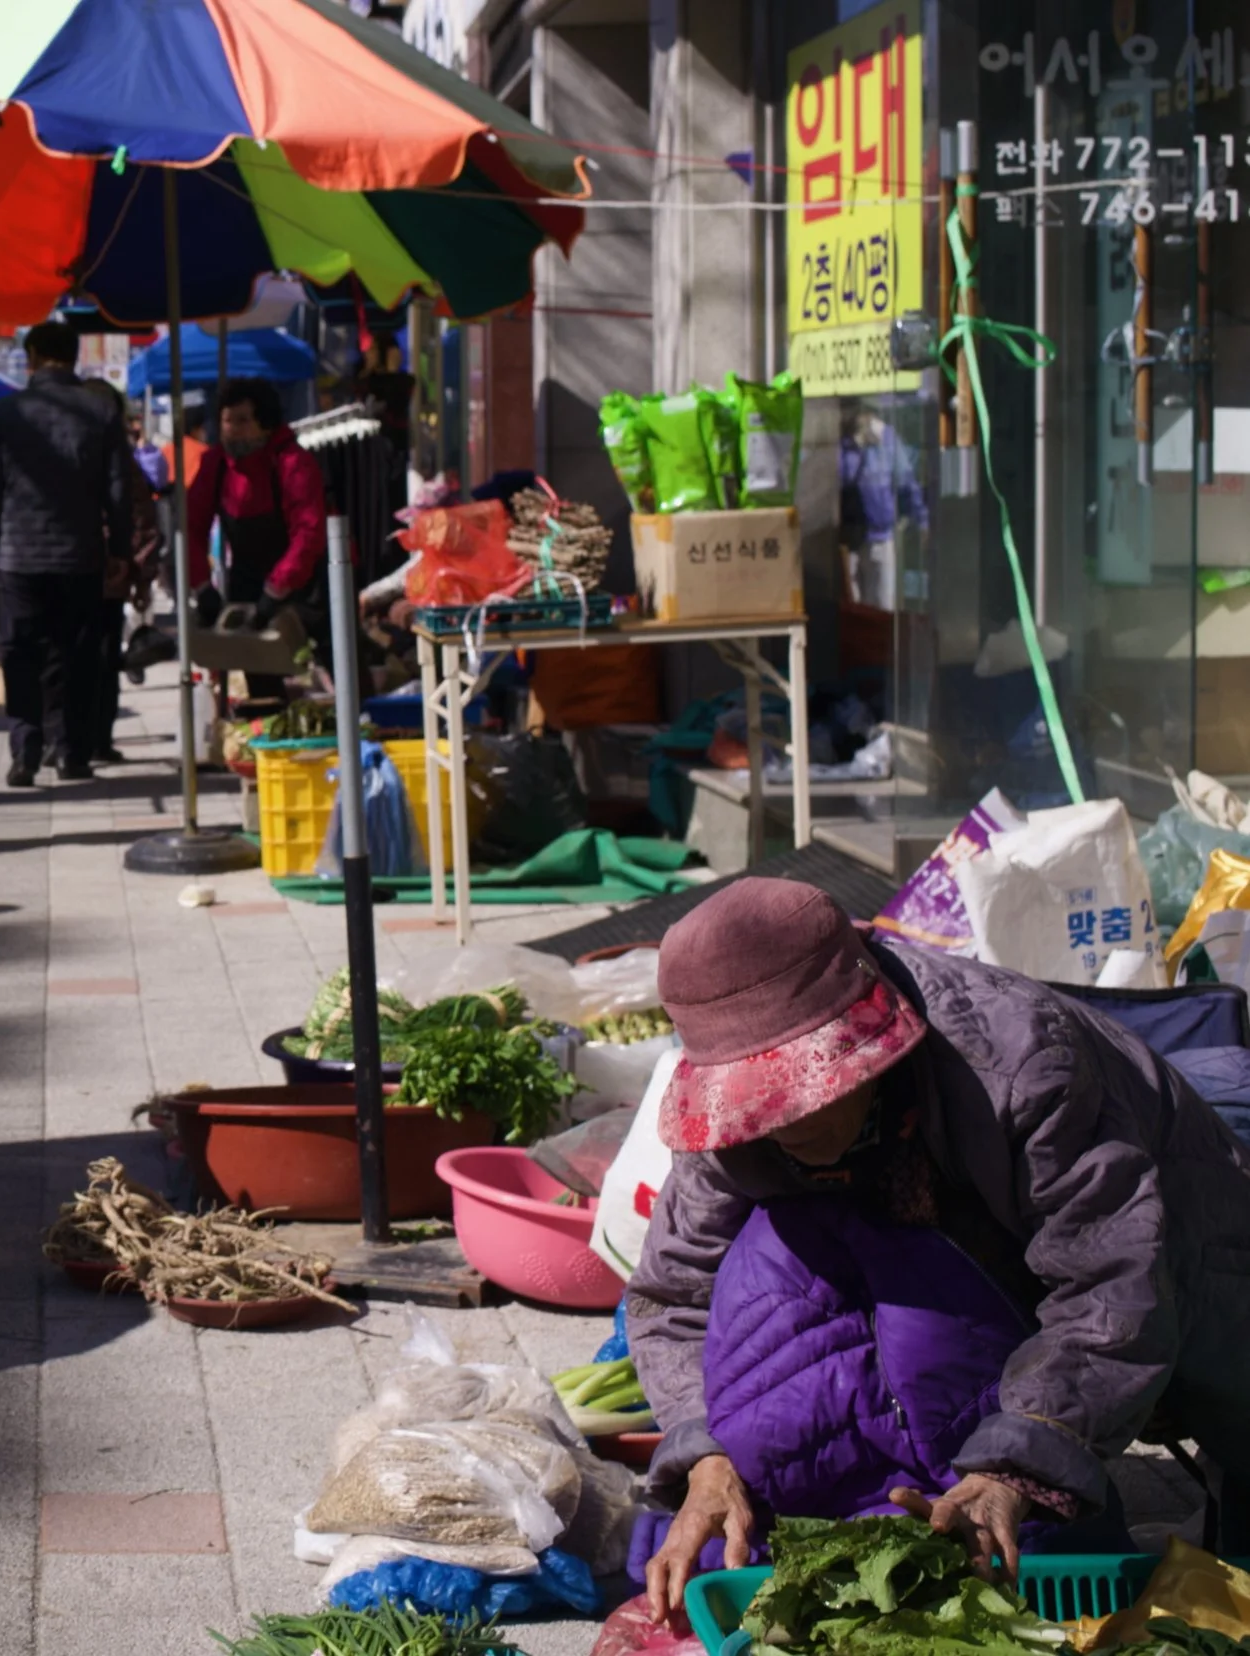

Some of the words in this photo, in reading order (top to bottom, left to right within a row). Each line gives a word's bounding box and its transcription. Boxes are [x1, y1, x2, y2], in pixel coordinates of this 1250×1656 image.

[978, 27, 1250, 98] 어서오세
[796, 12, 907, 227] 임대
[995, 138, 1065, 176] 전화
[1078, 188, 1250, 226] 746-41
[687, 537, 781, 564] 신선식품
[1067, 907, 1133, 949] 맞춤
